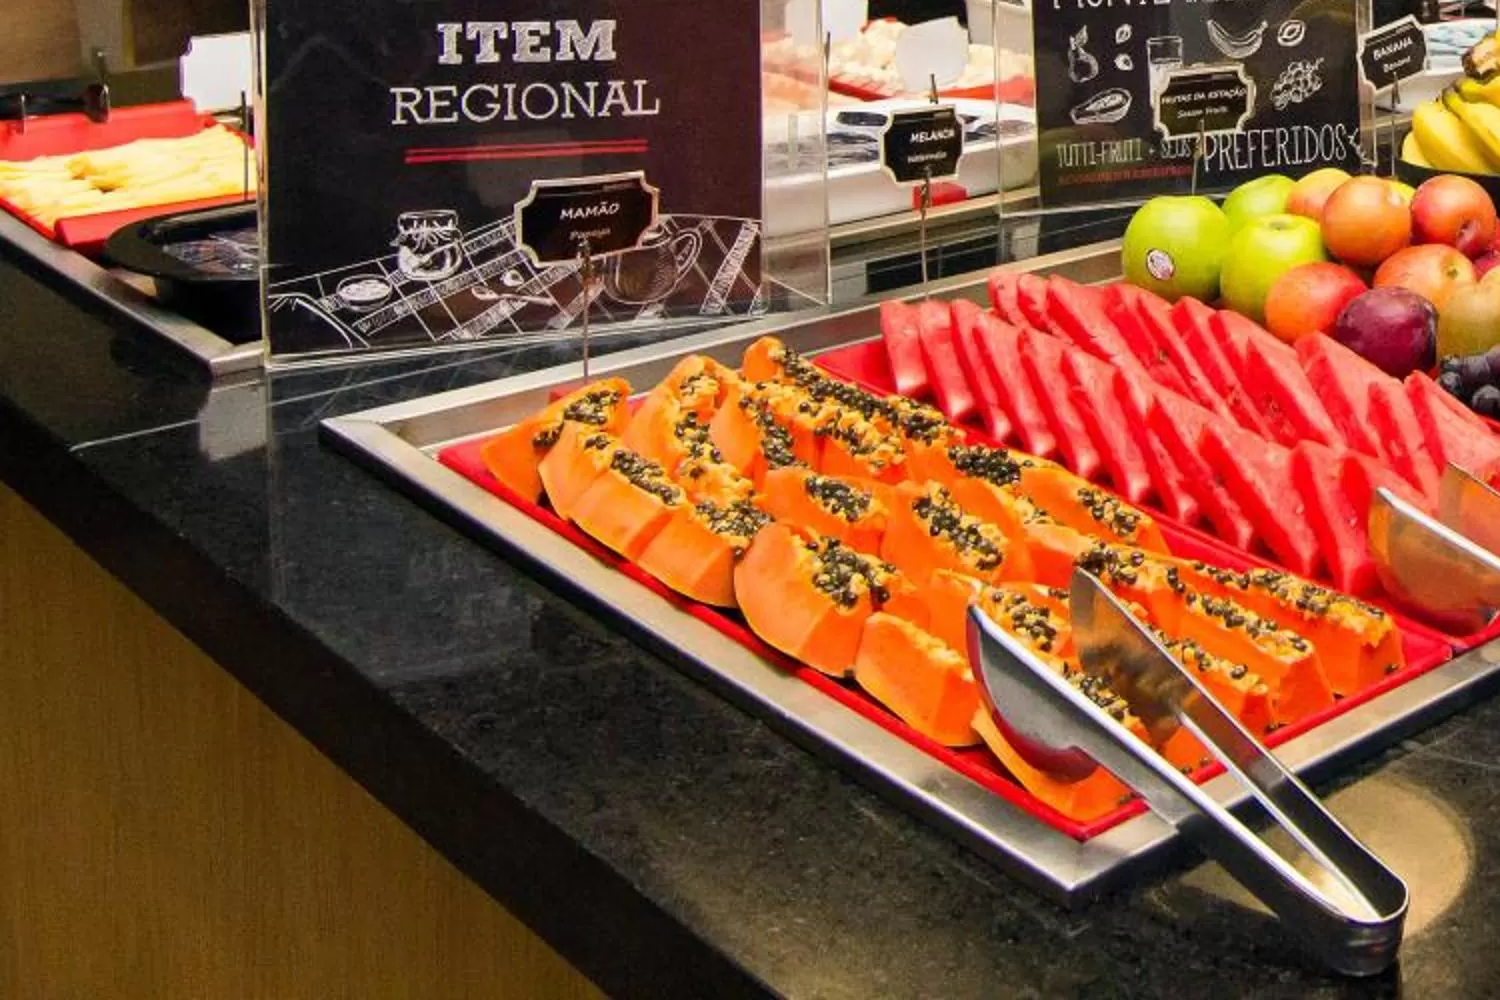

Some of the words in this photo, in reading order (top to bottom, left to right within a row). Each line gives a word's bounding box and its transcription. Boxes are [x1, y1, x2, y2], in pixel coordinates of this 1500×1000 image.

[437, 18, 618, 65] ITEM
[1373, 36, 1414, 61] BANANA
[390, 79, 660, 126] REGIONAL
[1203, 123, 1348, 173] PREFERIDOS
[559, 201, 621, 221] MAMÃO
